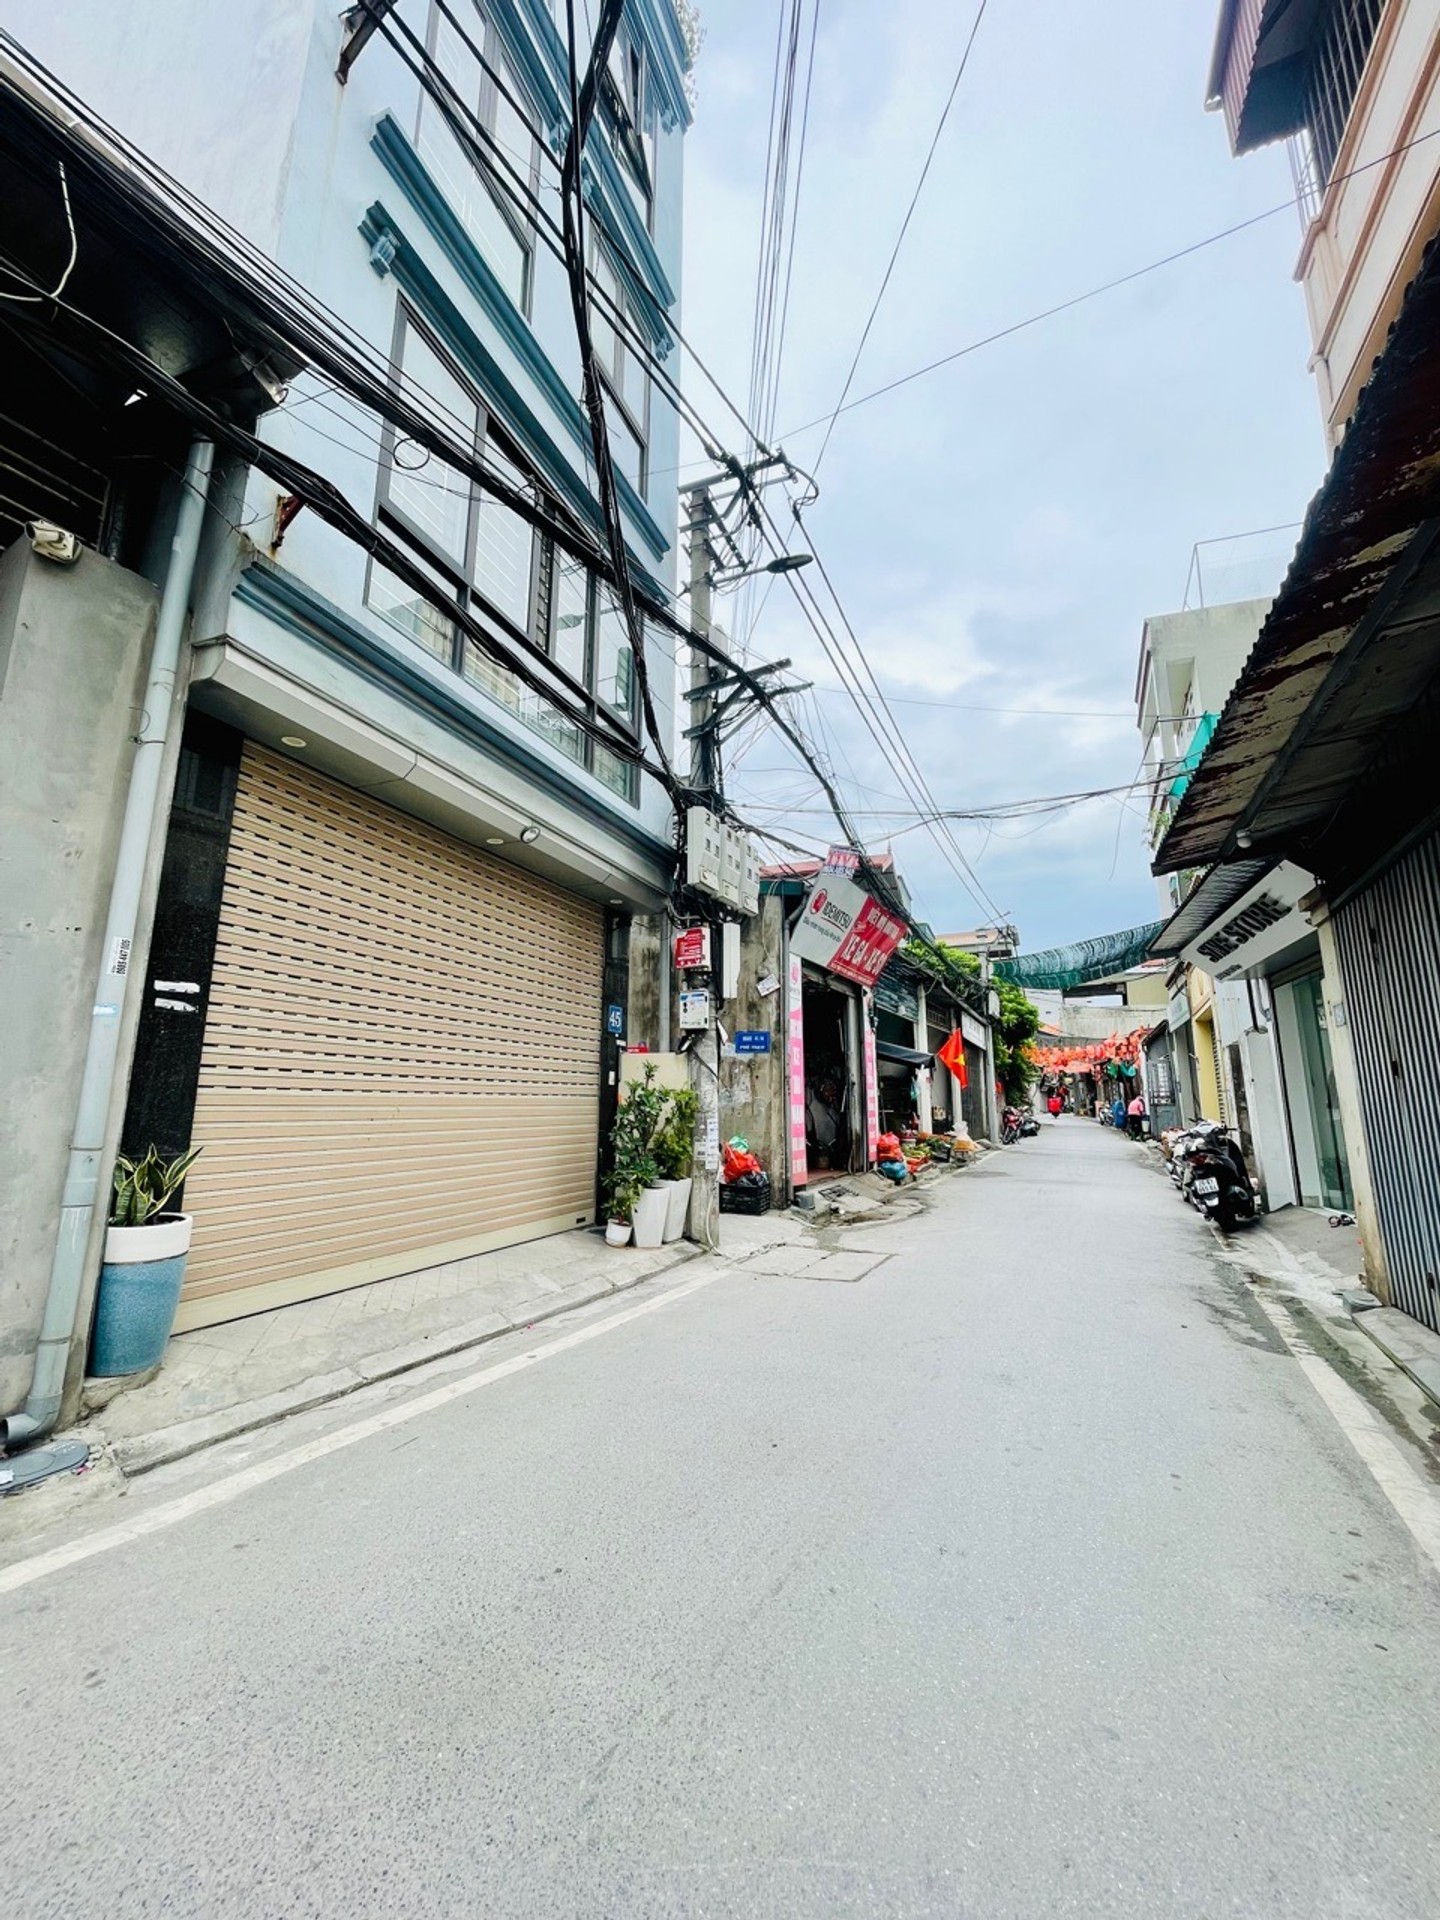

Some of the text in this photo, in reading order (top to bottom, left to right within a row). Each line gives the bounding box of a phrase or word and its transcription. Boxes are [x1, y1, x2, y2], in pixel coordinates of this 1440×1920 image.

[823, 901, 852, 930] IDEMITSU
[1221, 892, 1292, 945] STORE
[609, 1011, 621, 1028] 45
